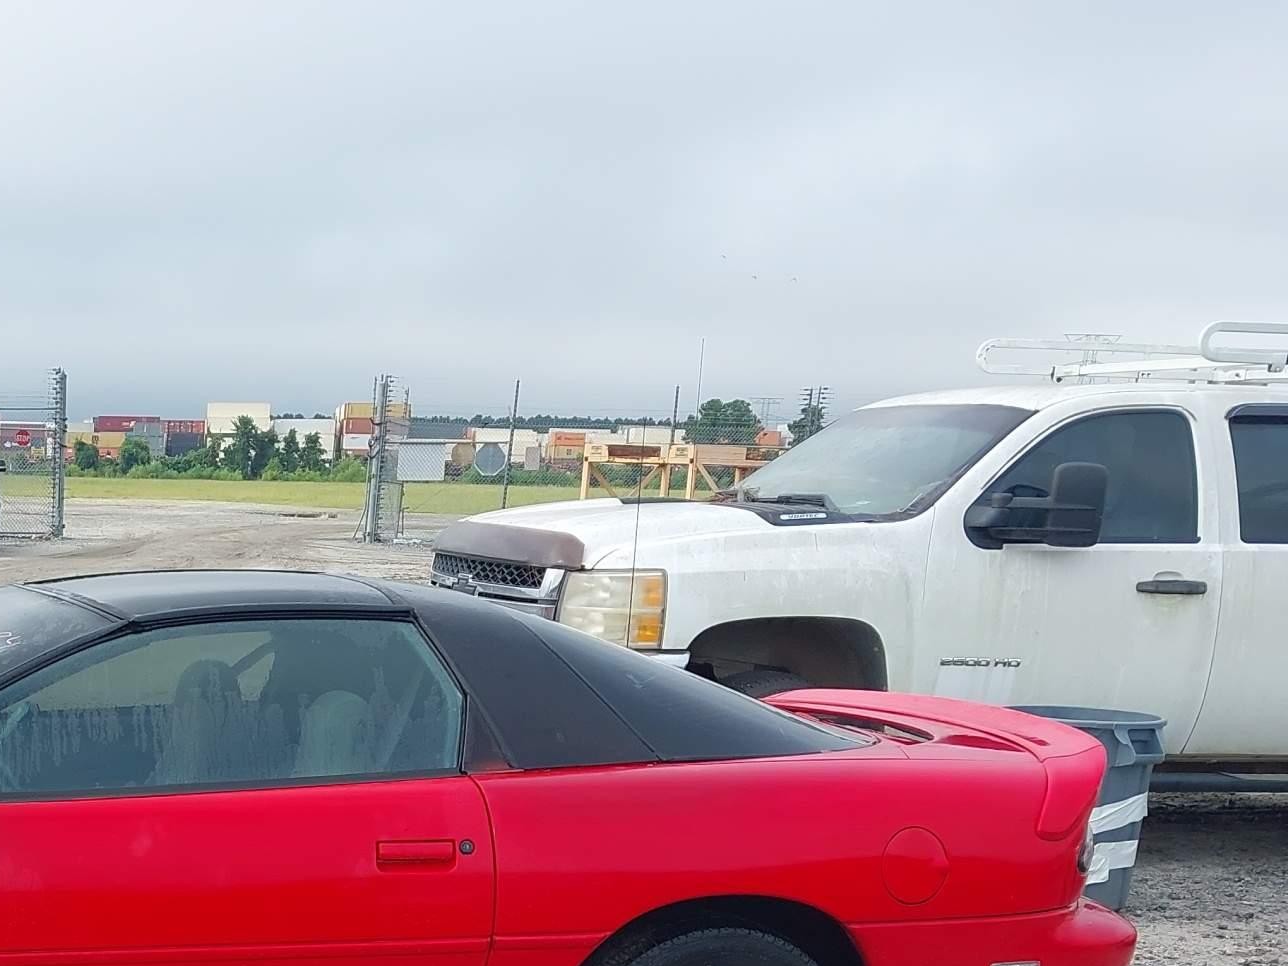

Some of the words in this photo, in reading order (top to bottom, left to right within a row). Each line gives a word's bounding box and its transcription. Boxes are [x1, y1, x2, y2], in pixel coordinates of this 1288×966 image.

[16, 434, 30, 442] STOP
[940, 657, 990, 667] 2500
[994, 658, 1021, 668] HD
